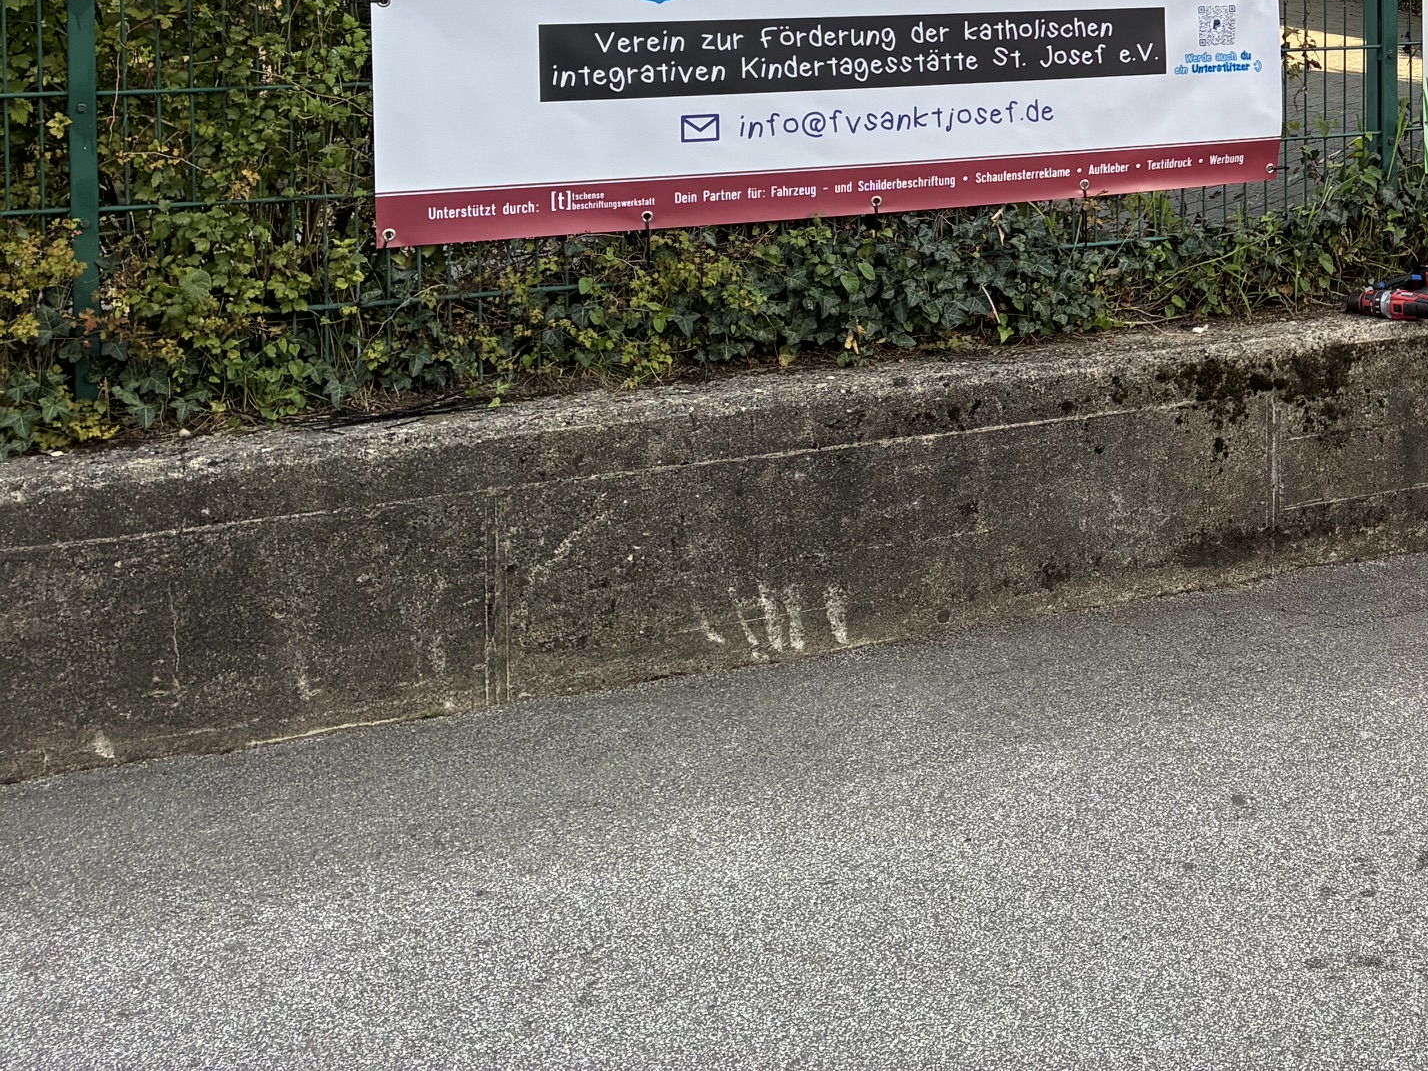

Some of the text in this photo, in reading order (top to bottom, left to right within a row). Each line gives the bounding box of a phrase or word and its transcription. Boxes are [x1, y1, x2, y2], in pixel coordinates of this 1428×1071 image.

[594, 17, 1113, 54] Verein zur Förderung der katholischen
[1185, 50, 1252, 64] Werde auch du
[551, 42, 1160, 93] integrativen Kindertagesstätte St. Josef e.V.
[1174, 65, 1188, 75] ein
[1191, 62, 1250, 74] Unterstützer
[739, 99, 1054, 139] info@fvsanktjosef.de
[674, 191, 697, 204] Dein
[702, 189, 742, 203] Partner
[747, 187, 765, 199] für:
[770, 185, 817, 199] Fahrzeug
[834, 181, 852, 194] und
[857, 173, 956, 192] Schilderbeschriftung
[975, 166, 1071, 184] Schaufensterreklame
[1088, 161, 1130, 175] Aufkleber
[1147, 156, 1192, 171] Textildruck
[1209, 152, 1244, 168] Werbung
[571, 197, 656, 211] beschriftungswerkstatt
[572, 191, 605, 201] tschense
[428, 201, 540, 220] Unterstützt durch:
